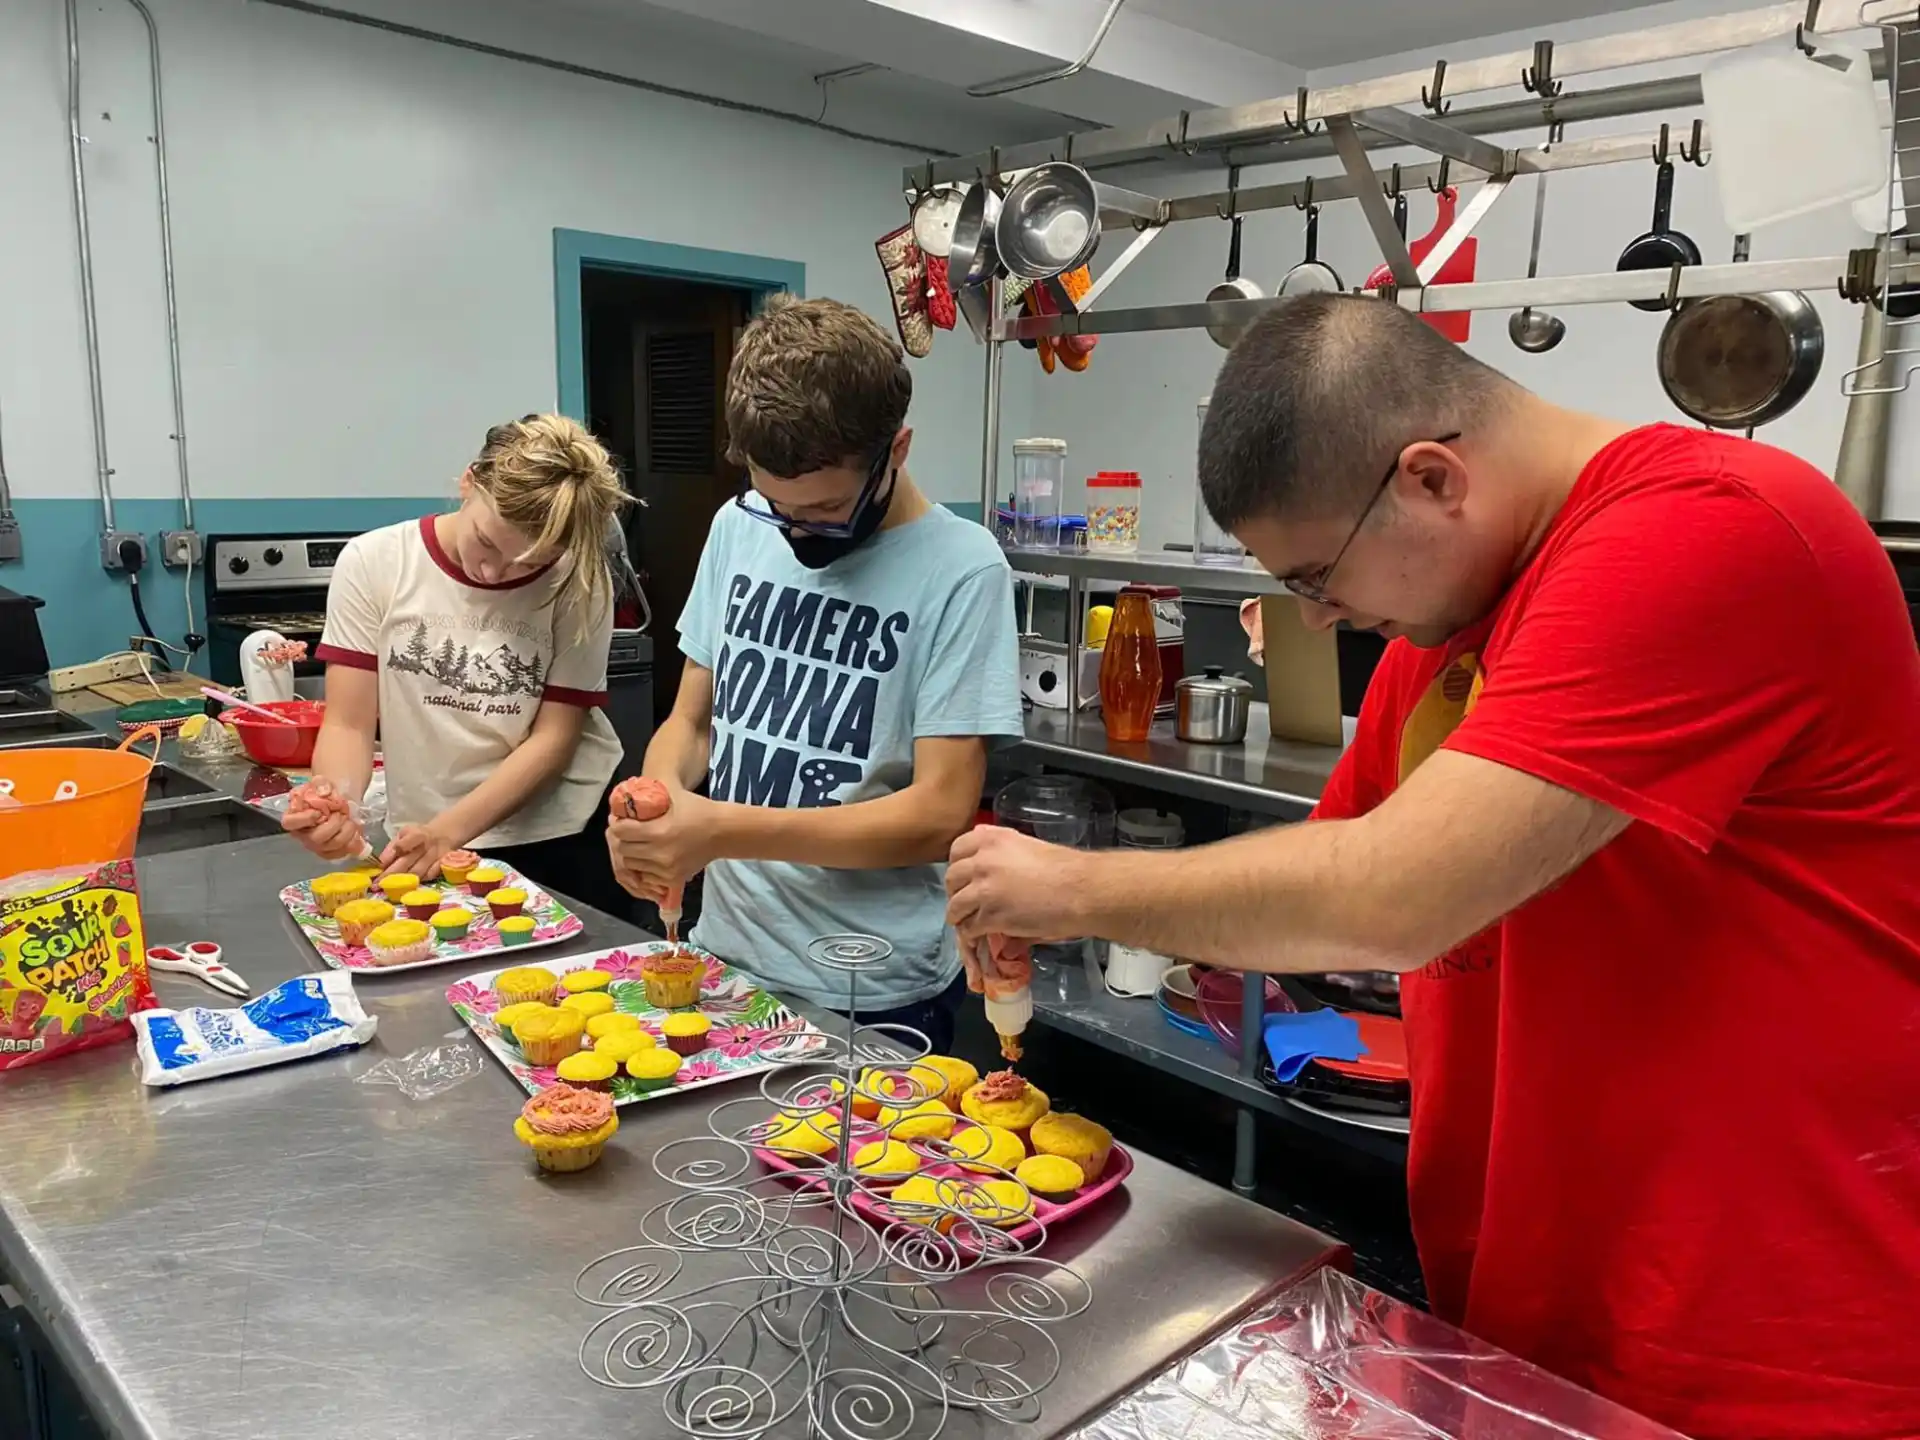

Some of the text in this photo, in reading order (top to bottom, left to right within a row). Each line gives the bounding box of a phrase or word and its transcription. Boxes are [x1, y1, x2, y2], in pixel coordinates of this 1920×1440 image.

[724, 574, 909, 673] GAMERS
[423, 693, 522, 716] national park
[712, 640, 880, 760] GONNA
[3, 898, 34, 914] SIZE
[21, 913, 100, 967] SOUR
[25, 936, 110, 988] PATCH
